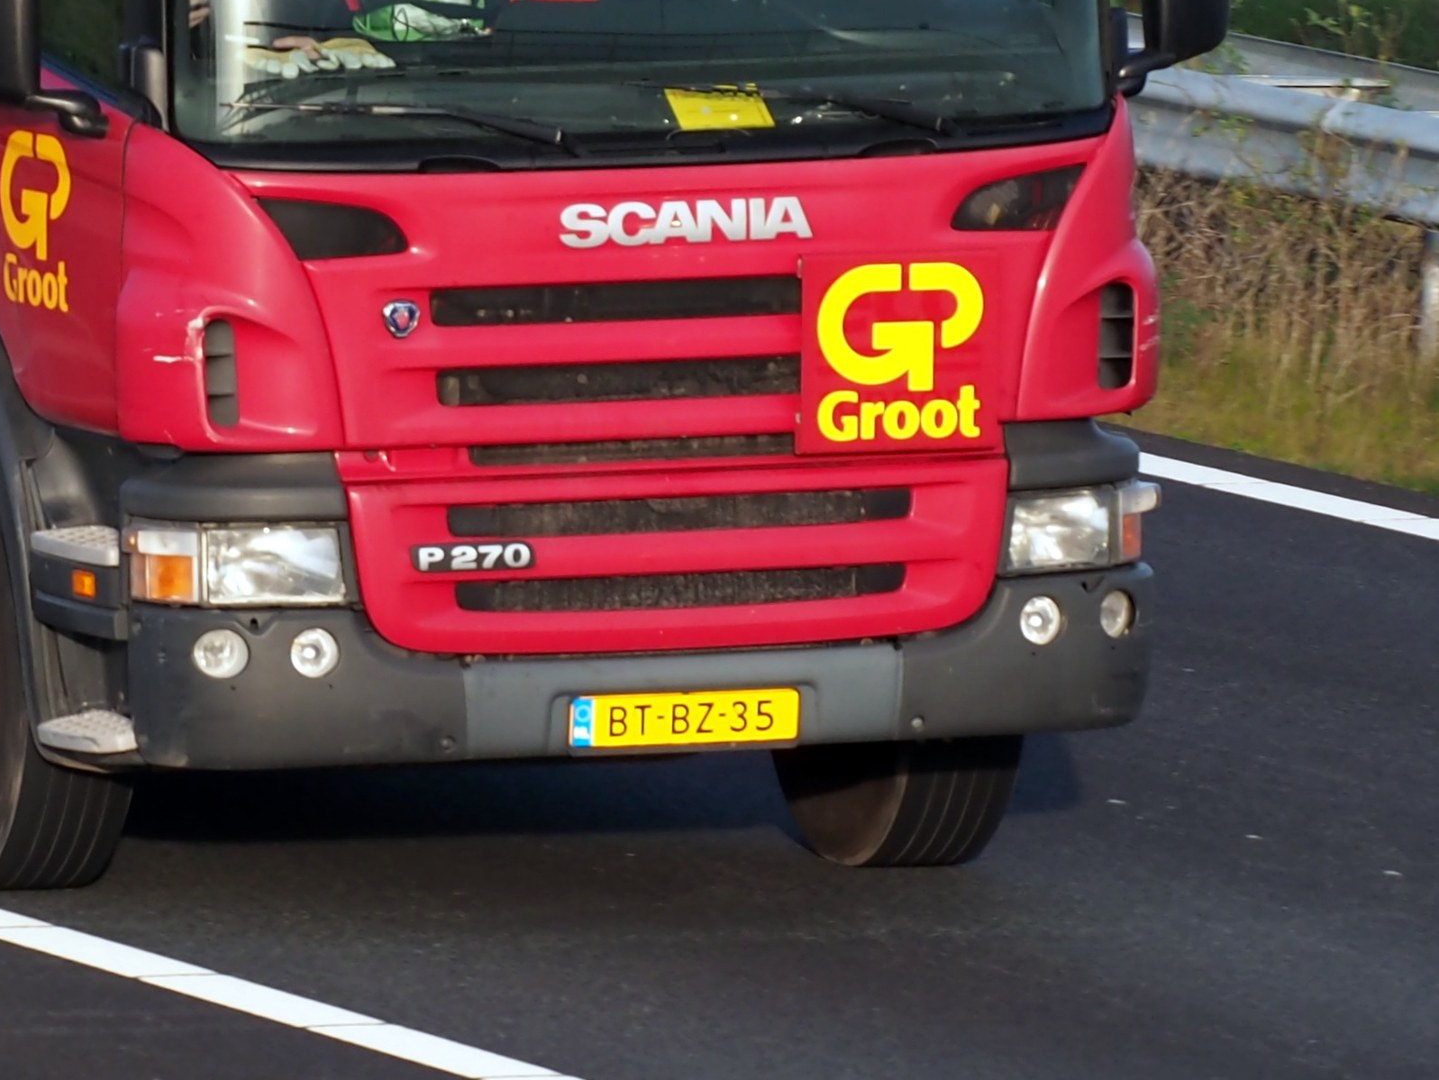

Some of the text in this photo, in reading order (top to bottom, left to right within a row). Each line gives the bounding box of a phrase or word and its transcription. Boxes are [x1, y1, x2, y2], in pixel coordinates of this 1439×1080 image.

[559, 196, 813, 248] SCANIA
[3, 253, 68, 312] Groot
[817, 385, 980, 441] Groot
[418, 543, 531, 571] P 270
[609, 700, 774, 738] BT-BZ-35
